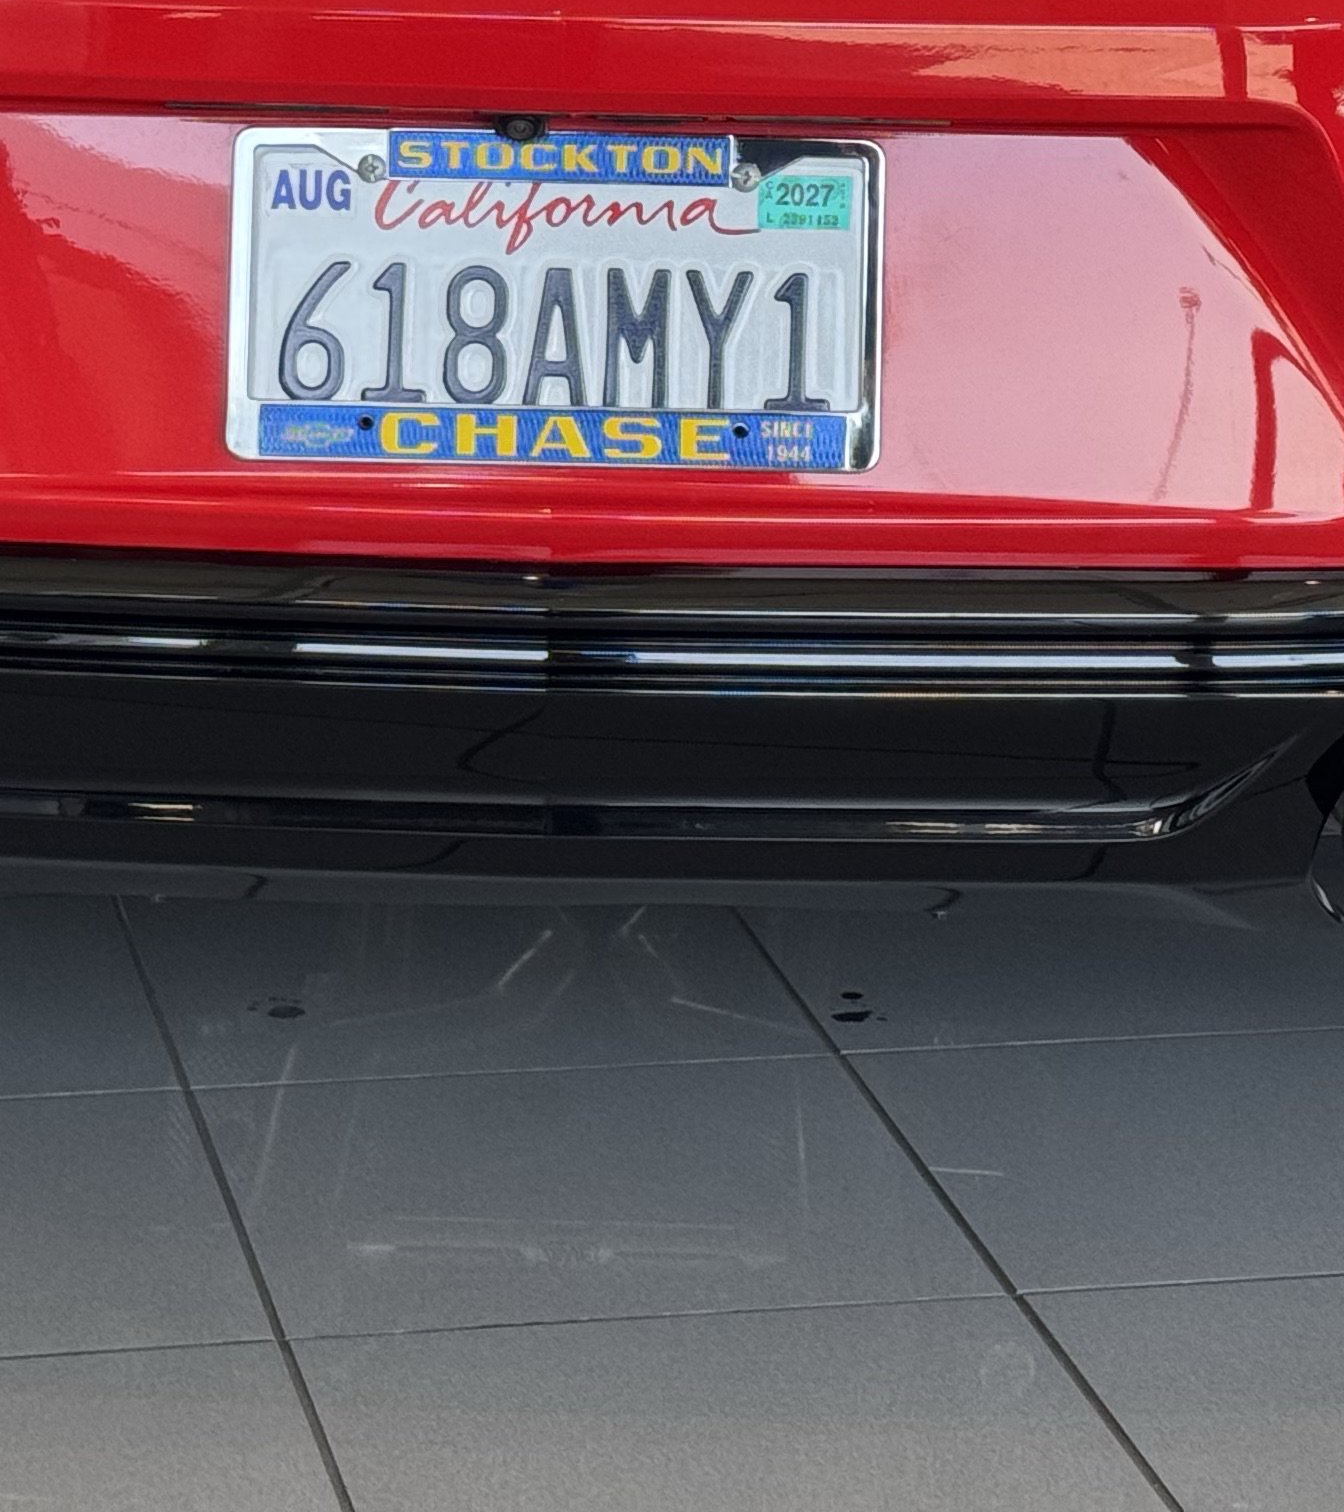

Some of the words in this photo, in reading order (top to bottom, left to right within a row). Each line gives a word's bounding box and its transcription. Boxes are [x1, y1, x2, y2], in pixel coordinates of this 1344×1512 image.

[398, 140, 723, 176] STOCKTON
[270, 169, 352, 212] AUG
[775, 183, 835, 207] 2027
[374, 179, 761, 255] California
[278, 260, 831, 410] 618AMY1
[378, 411, 731, 460] CHASE
[767, 444, 811, 462] 1944
